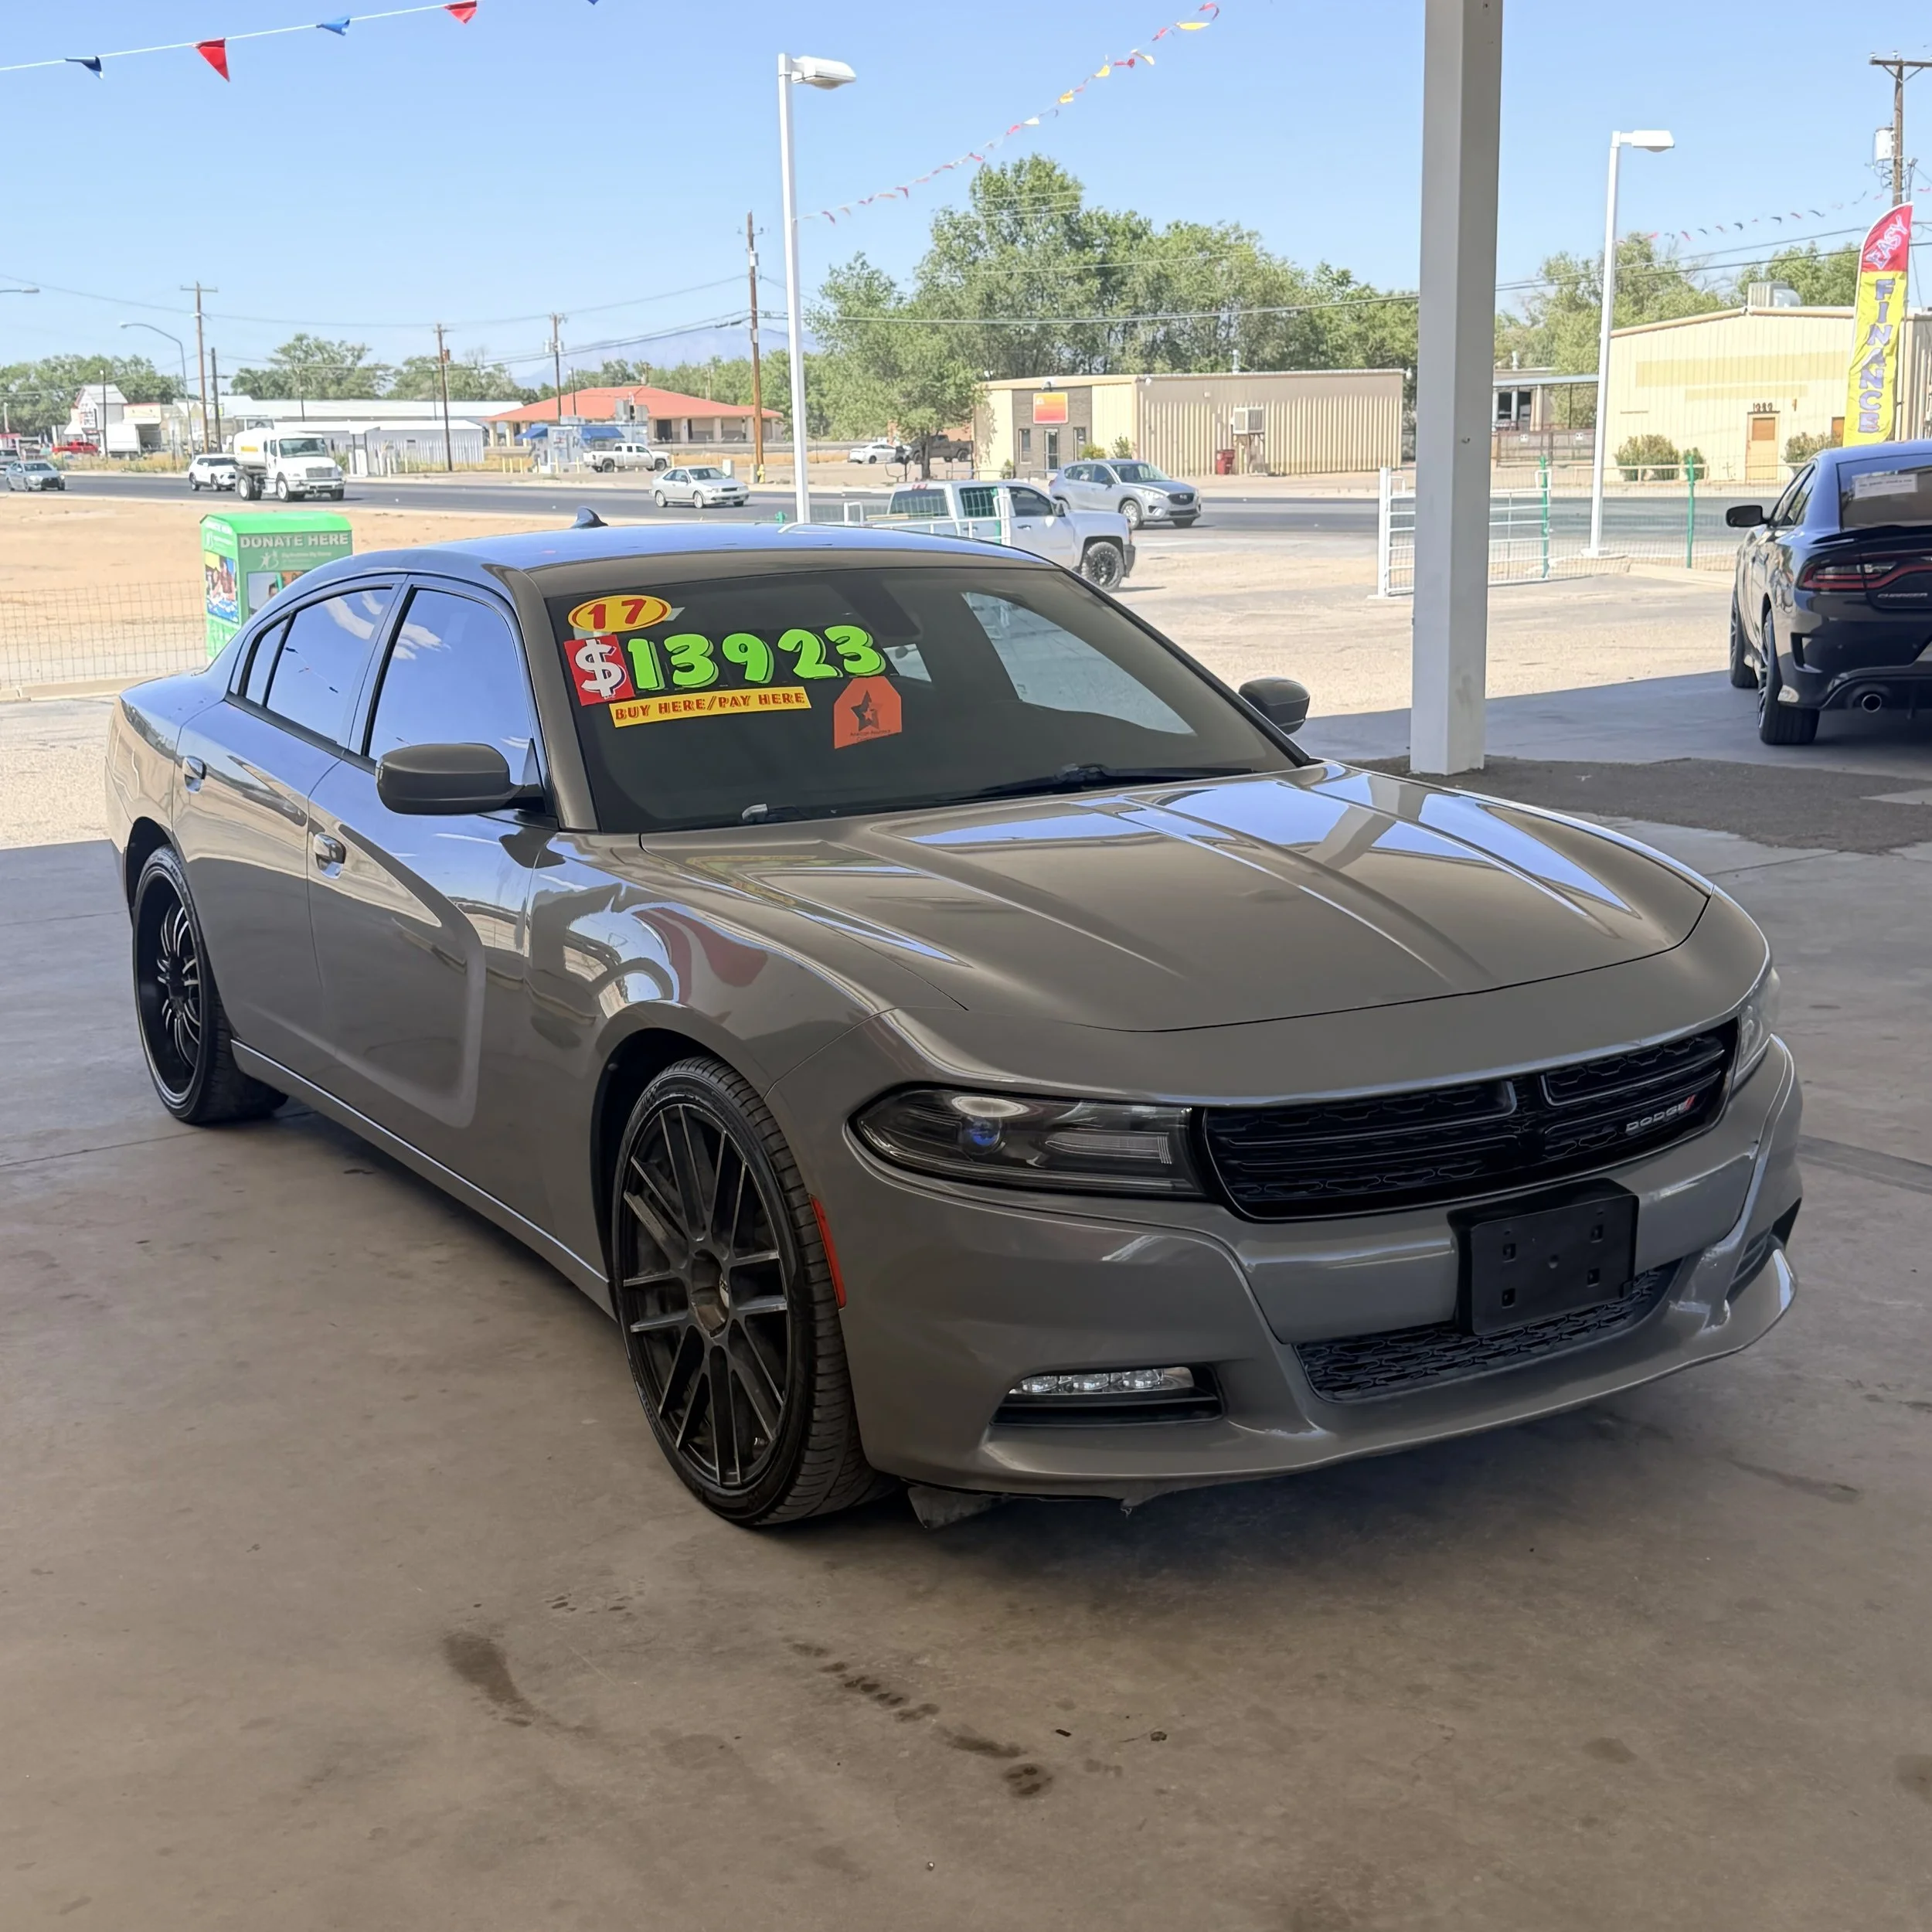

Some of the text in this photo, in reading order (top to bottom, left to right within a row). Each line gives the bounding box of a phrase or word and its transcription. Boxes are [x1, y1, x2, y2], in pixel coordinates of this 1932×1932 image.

[1866, 215, 1909, 269] EASY
[1858, 279, 1896, 433] FINANCE
[240, 536, 303, 548] DONATE
[308, 533, 349, 546] HERE
[587, 599, 647, 629] 17
[575, 624, 886, 699] $13923
[615, 692, 806, 720] BUY HERE/PAY HERE
[1625, 1101, 1688, 1132] DODGE
